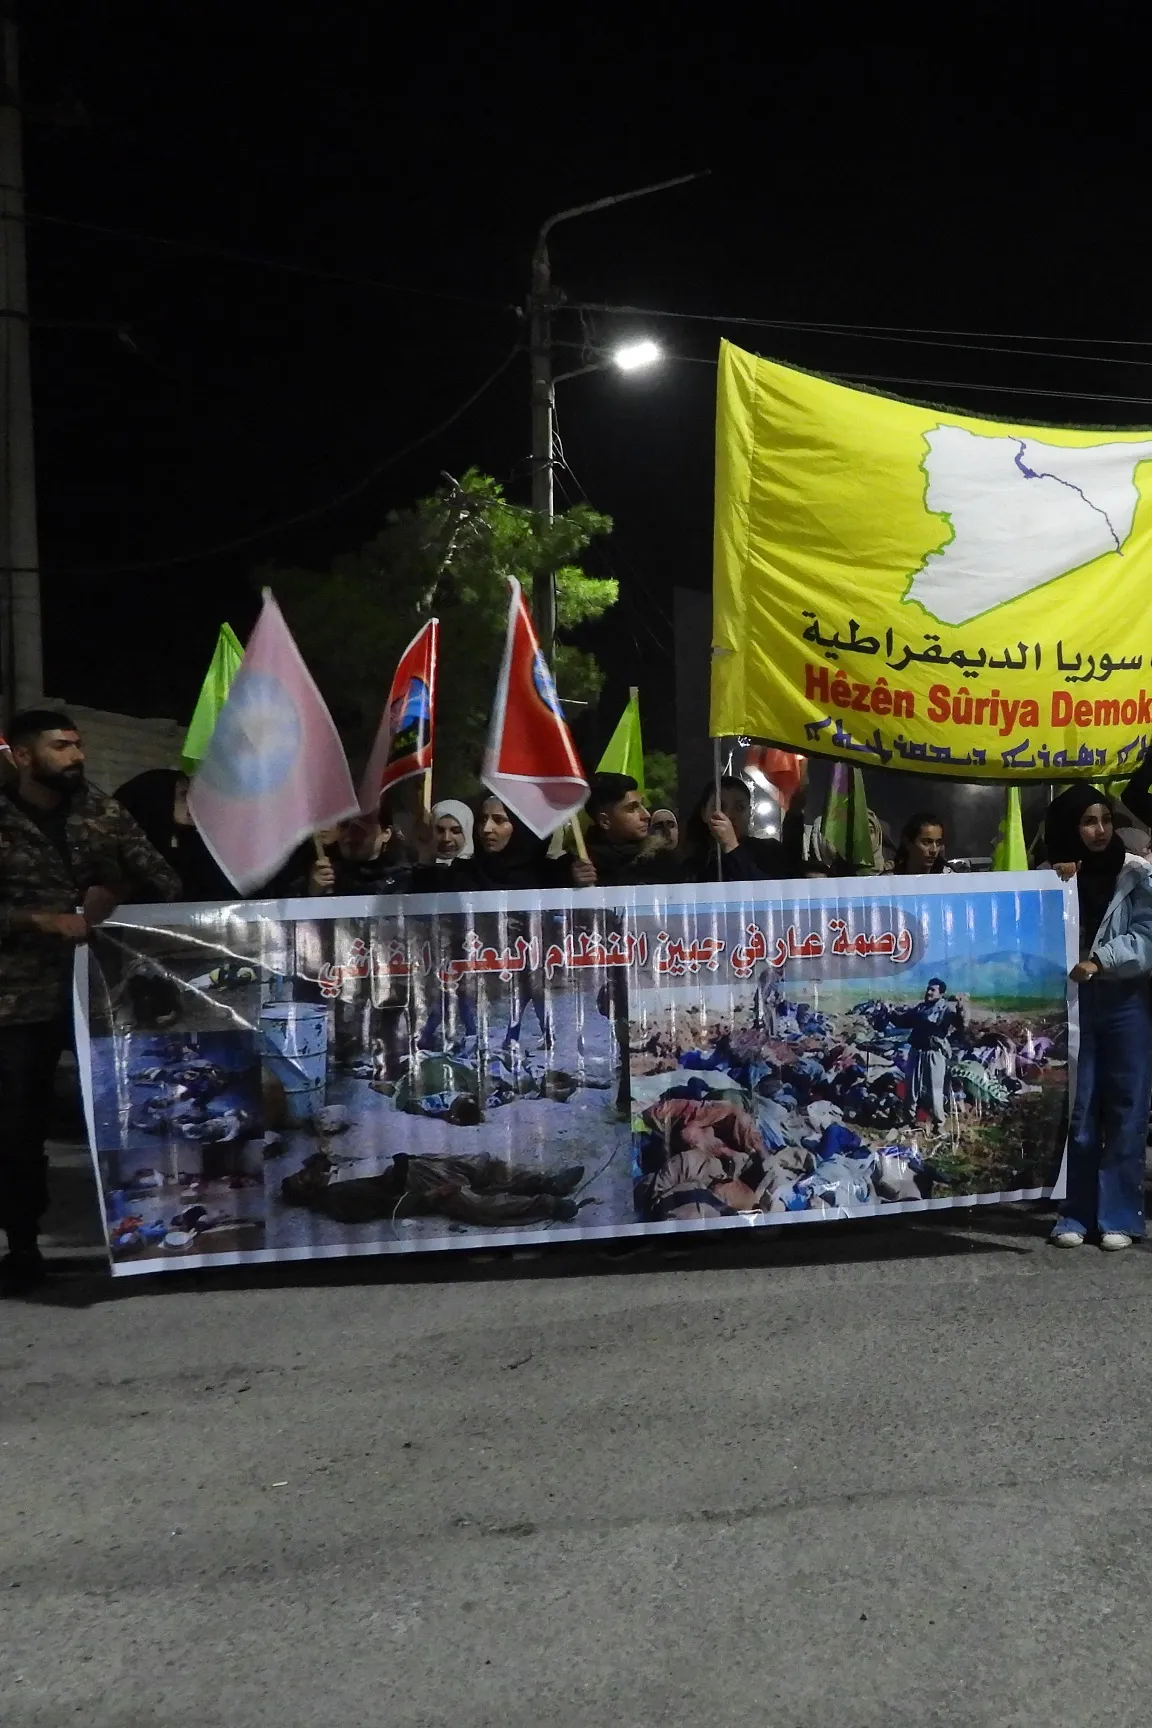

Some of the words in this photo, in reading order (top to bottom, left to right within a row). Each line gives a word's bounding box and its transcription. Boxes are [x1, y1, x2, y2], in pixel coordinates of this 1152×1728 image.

[801, 609, 1042, 679] الديمقراطية
[1056, 640, 1143, 683] سوريا
[805, 663, 915, 719] Hêzên
[927, 683, 1040, 737] Sûriya
[436, 929, 540, 992] البعثي
[543, 929, 648, 980] النظام
[655, 930, 726, 976] جبين
[728, 923, 768, 980] في
[768, 925, 826, 968] عار
[828, 918, 913, 963] وصمة
